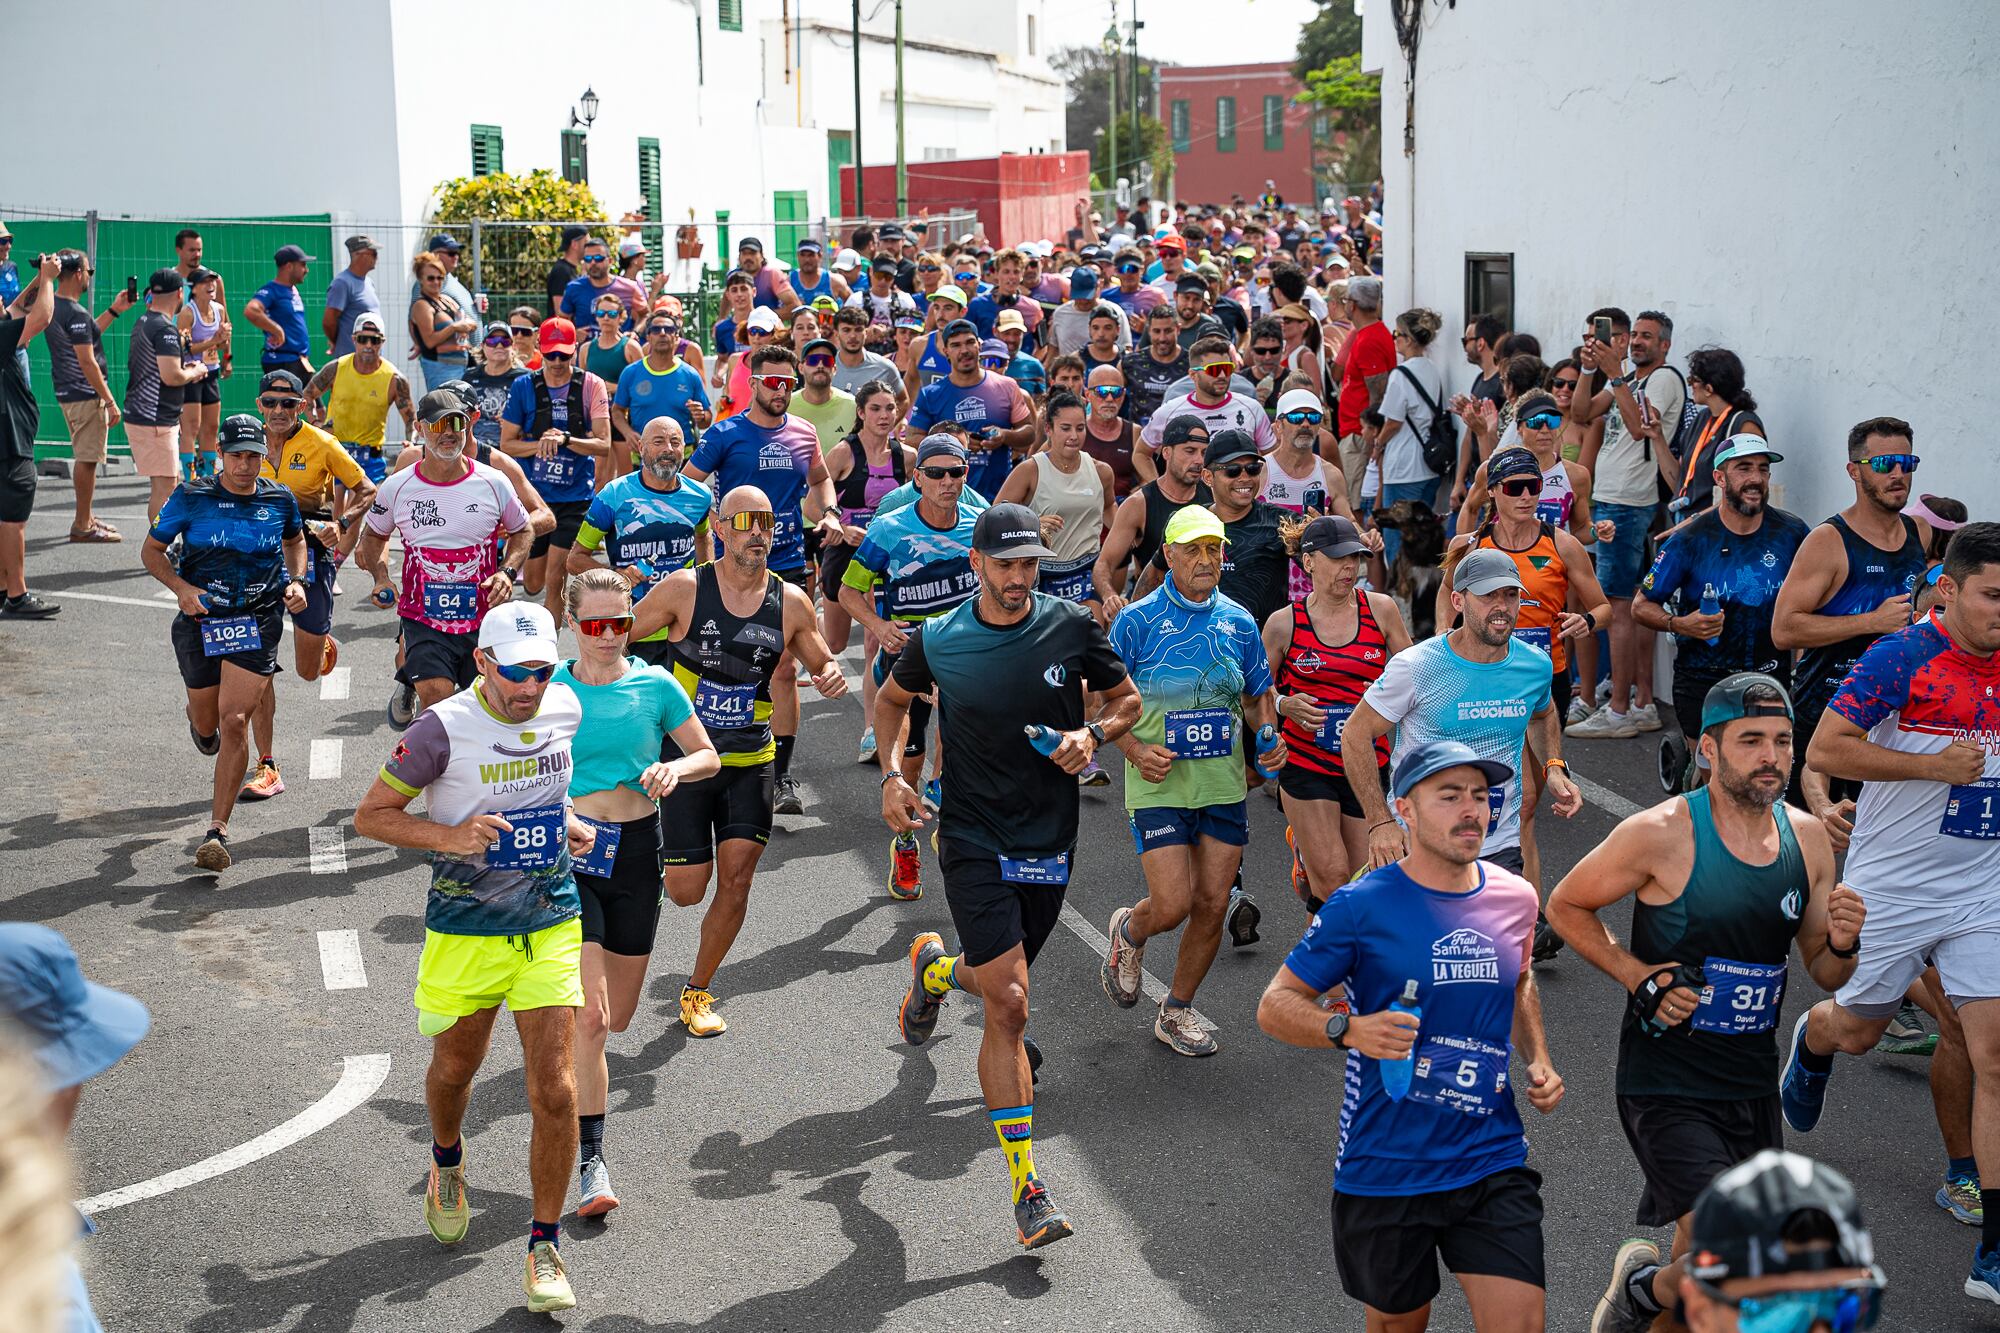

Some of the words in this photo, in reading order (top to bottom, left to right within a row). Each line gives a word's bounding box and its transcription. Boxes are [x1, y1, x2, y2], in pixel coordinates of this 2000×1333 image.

[956, 412, 963, 421] LA
[964, 409, 986, 419] VEGUETA
[547, 462, 563, 474] 78
[760, 459, 767, 468] LA
[768, 458, 793, 468] VEGUETA
[1001, 530, 1038, 539] SALOMON
[620, 541, 667, 559] CHIMIA
[1866, 565, 1885, 573] GOBIK
[898, 578, 952, 602] CHIMIA
[1057, 583, 1082, 598] 118
[438, 594, 461, 608] 64
[213, 625, 248, 642] 102
[708, 695, 742, 713] 141
[1457, 699, 1501, 708] RELEVOS
[701, 708, 716, 718] KNUT
[716, 713, 745, 721] ALEJANDRO
[1186, 723, 1213, 742] 68
[480, 749, 571, 784] wineRUN
[494, 772, 565, 795] LANZAROTE
[1981, 796, 1992, 818] 1
[513, 825, 547, 849] 88
[1451, 933, 1477, 946] Trail
[1432, 943, 1461, 956] Sam
[1462, 945, 1496, 958] Parfums
[1433, 963, 1448, 981] LA
[1450, 961, 1499, 979] VEGUETA
[1718, 963, 1726, 972] LA
[1727, 965, 1750, 976] VEGUETA
[1731, 984, 1767, 1011] 31
[1735, 1014, 1756, 1023] David
[1436, 1036, 1444, 1044] LA
[1444, 1038, 1466, 1049] VEGUETA
[1455, 1060, 1479, 1088] 5
[1001, 1122, 1029, 1136] RUN
